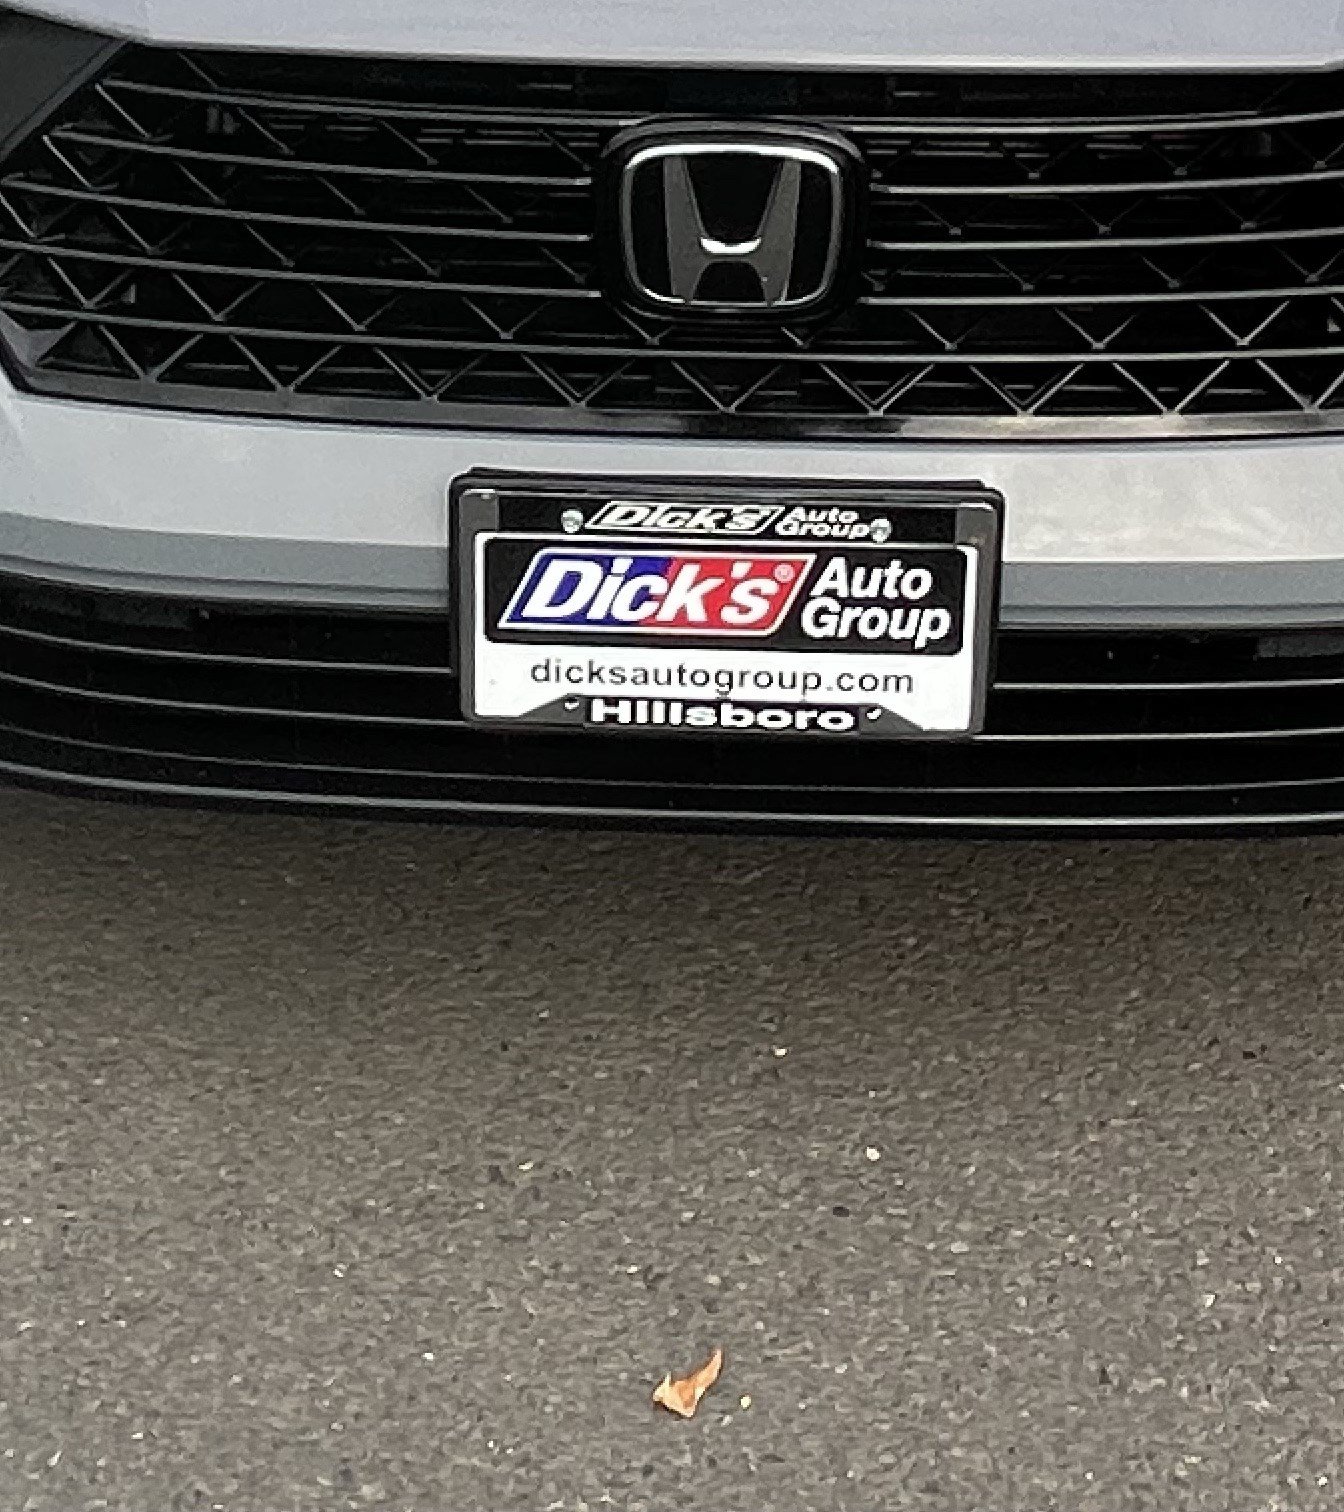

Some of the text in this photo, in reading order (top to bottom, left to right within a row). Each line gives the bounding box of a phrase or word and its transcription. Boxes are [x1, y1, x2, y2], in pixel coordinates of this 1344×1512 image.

[774, 521, 870, 539] Group
[779, 506, 859, 524] Auto
[521, 556, 933, 626] Dick's Auto
[801, 598, 951, 649] Group
[530, 658, 914, 702] dicksautogroup.com
[590, 698, 855, 730] Hillsboro
